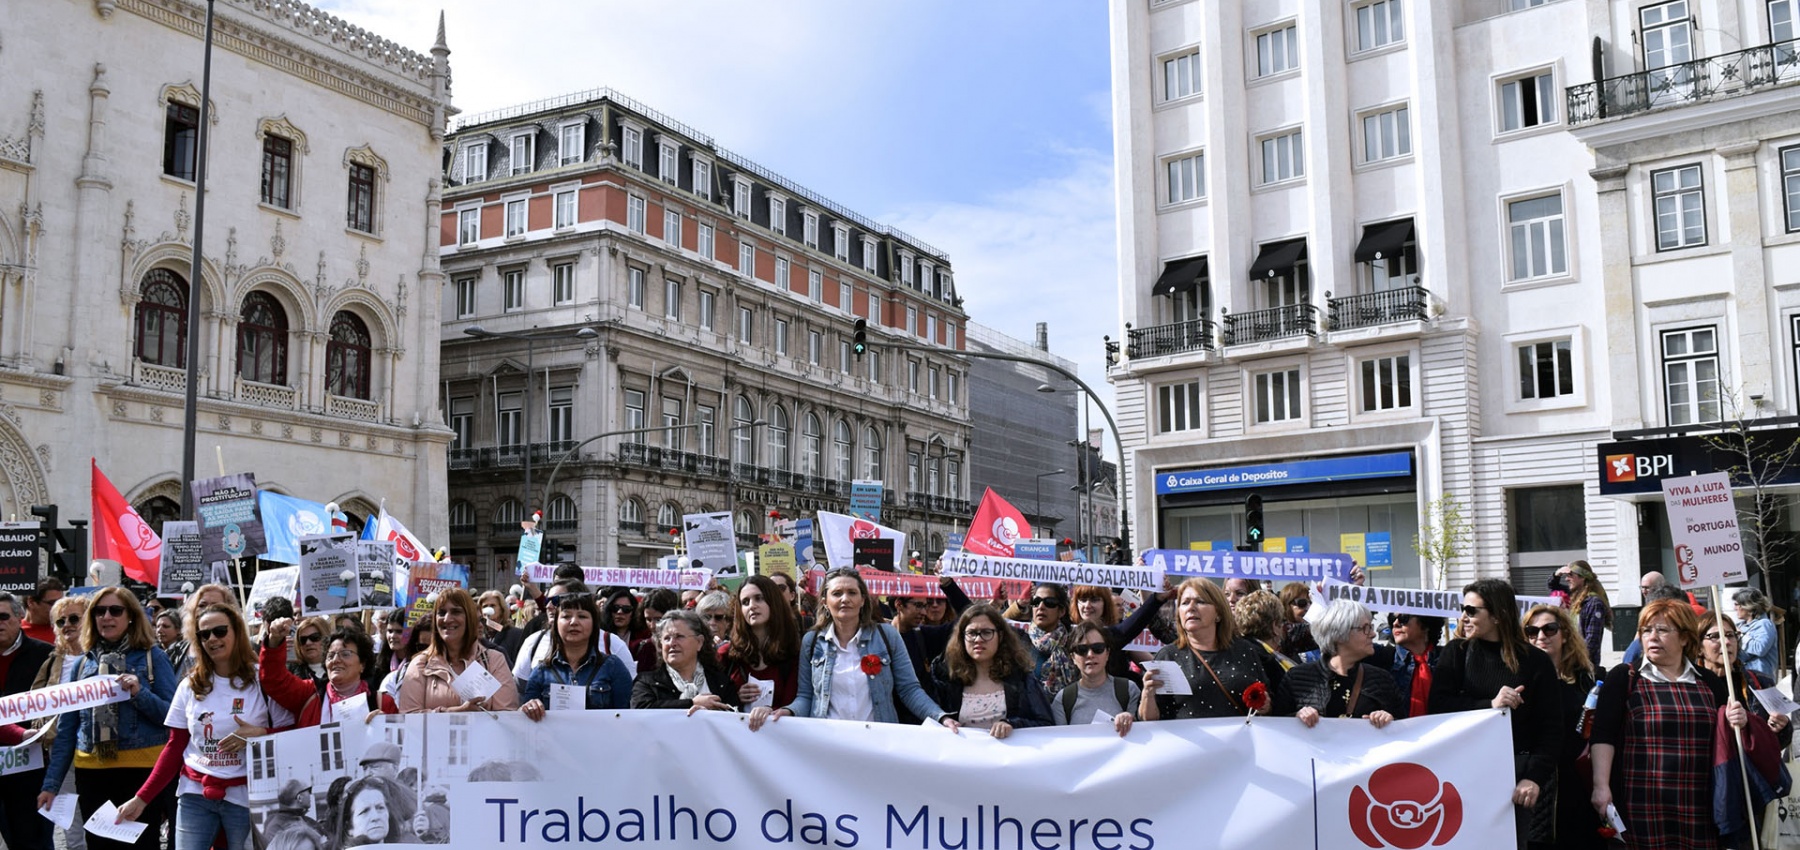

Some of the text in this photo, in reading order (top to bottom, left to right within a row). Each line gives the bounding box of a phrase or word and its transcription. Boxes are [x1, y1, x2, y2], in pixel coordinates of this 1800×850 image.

[1636, 455, 1674, 478] BPI
[1180, 469, 1288, 486] Caixa Geral de Depositos
[201, 491, 250, 503] PROSTITUIÇÃO!
[1669, 482, 1725, 497] VIVA A LUTA
[1682, 494, 1729, 507] MULHERES
[1688, 520, 1737, 534] PORTUGAL
[0, 534, 36, 542] ABALHO
[1704, 543, 1740, 555] MUNDO
[950, 554, 1156, 588] NÃO À DISCRIMINAÇÃO SALARIAL
[1153, 552, 1342, 577] A PAZ É URGENTE!
[606, 569, 627, 583] SEM
[50, 679, 117, 709] SALARIAL
[485, 795, 1156, 850] Trabalho das Mulheres
